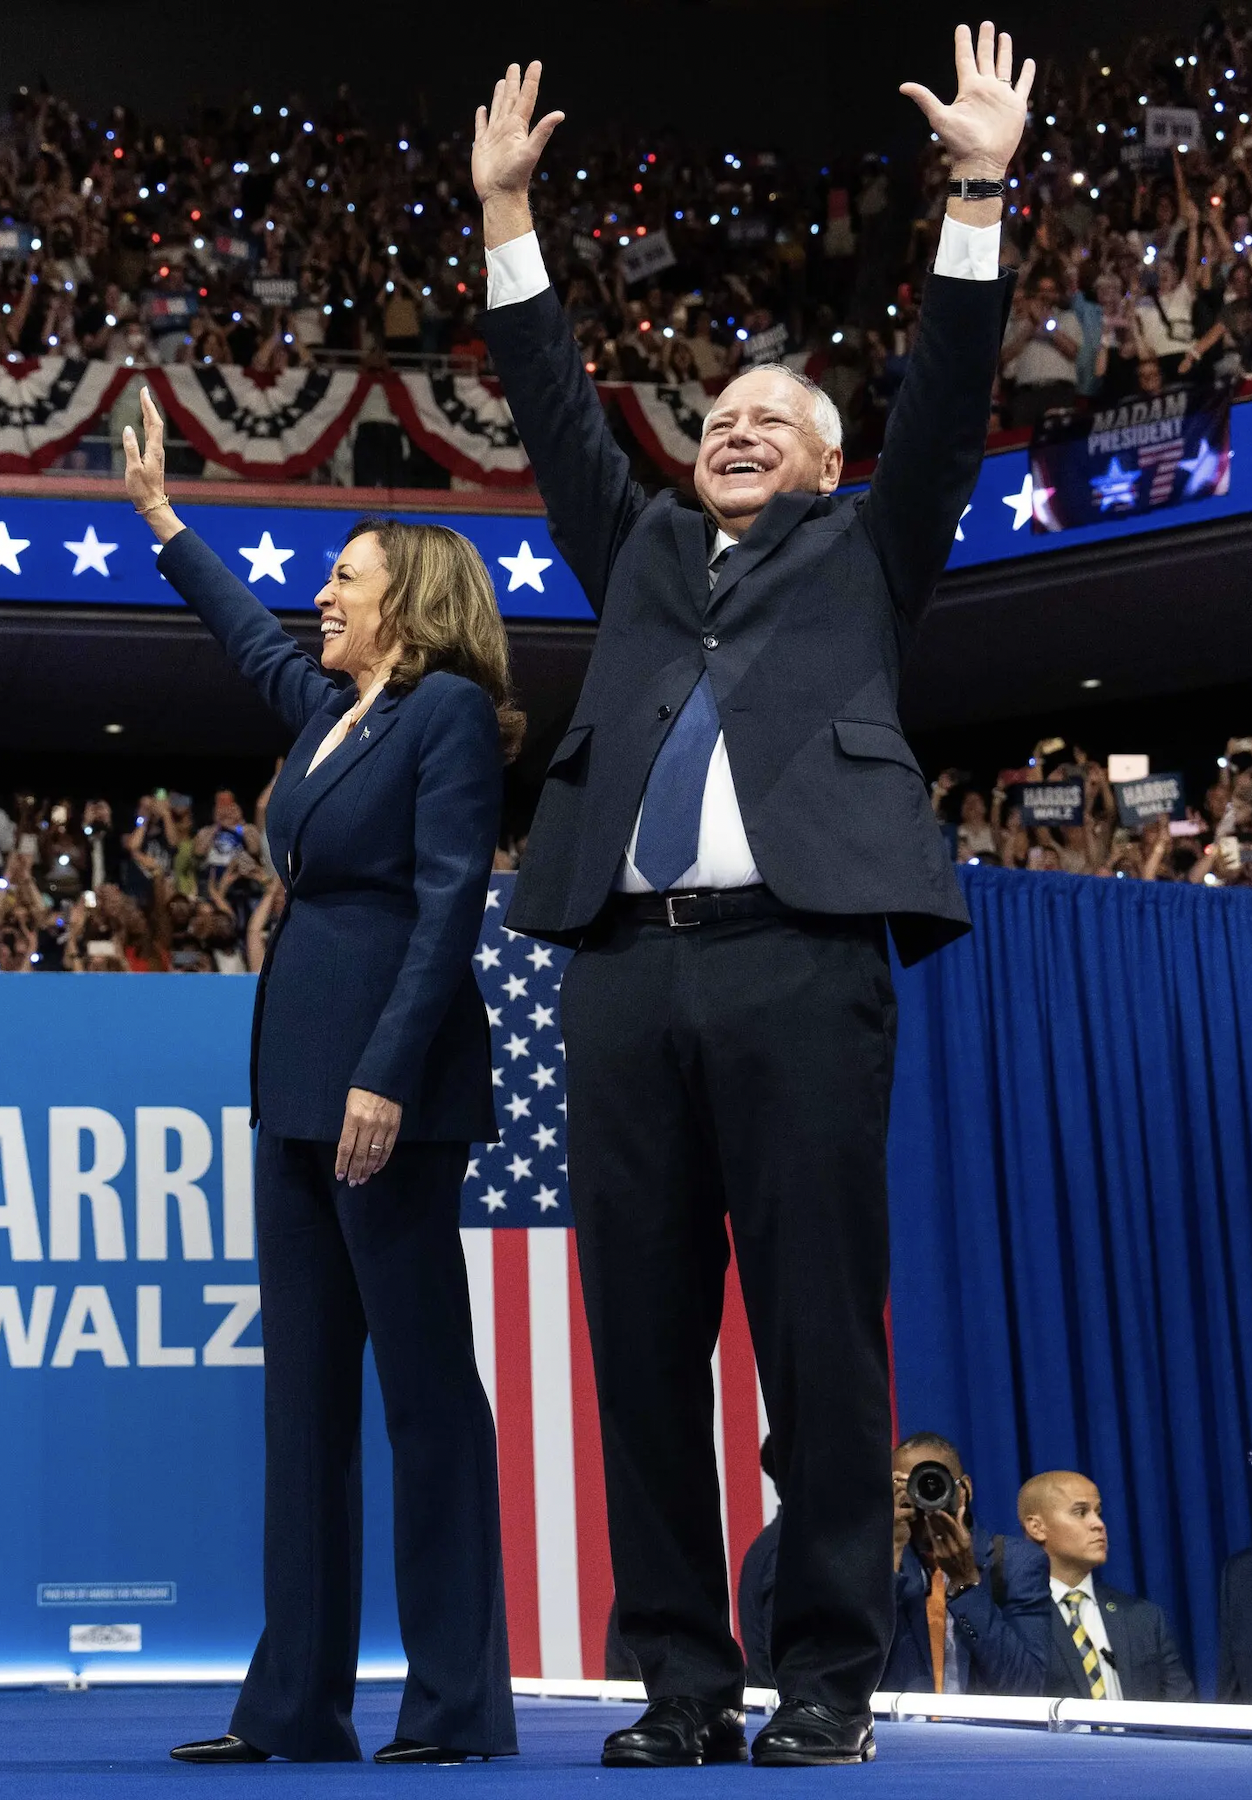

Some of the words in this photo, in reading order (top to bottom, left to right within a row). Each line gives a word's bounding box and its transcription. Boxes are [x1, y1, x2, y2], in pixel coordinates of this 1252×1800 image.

[1092, 391, 1188, 432] MADAM
[1087, 415, 1184, 456] PRESIDENT
[1023, 786, 1082, 808] HARRIS
[1122, 778, 1181, 809] HARRIS
[1136, 799, 1175, 818] WALZ
[1033, 806, 1074, 821] WALZ
[0, 1284, 265, 1368] WALZ
